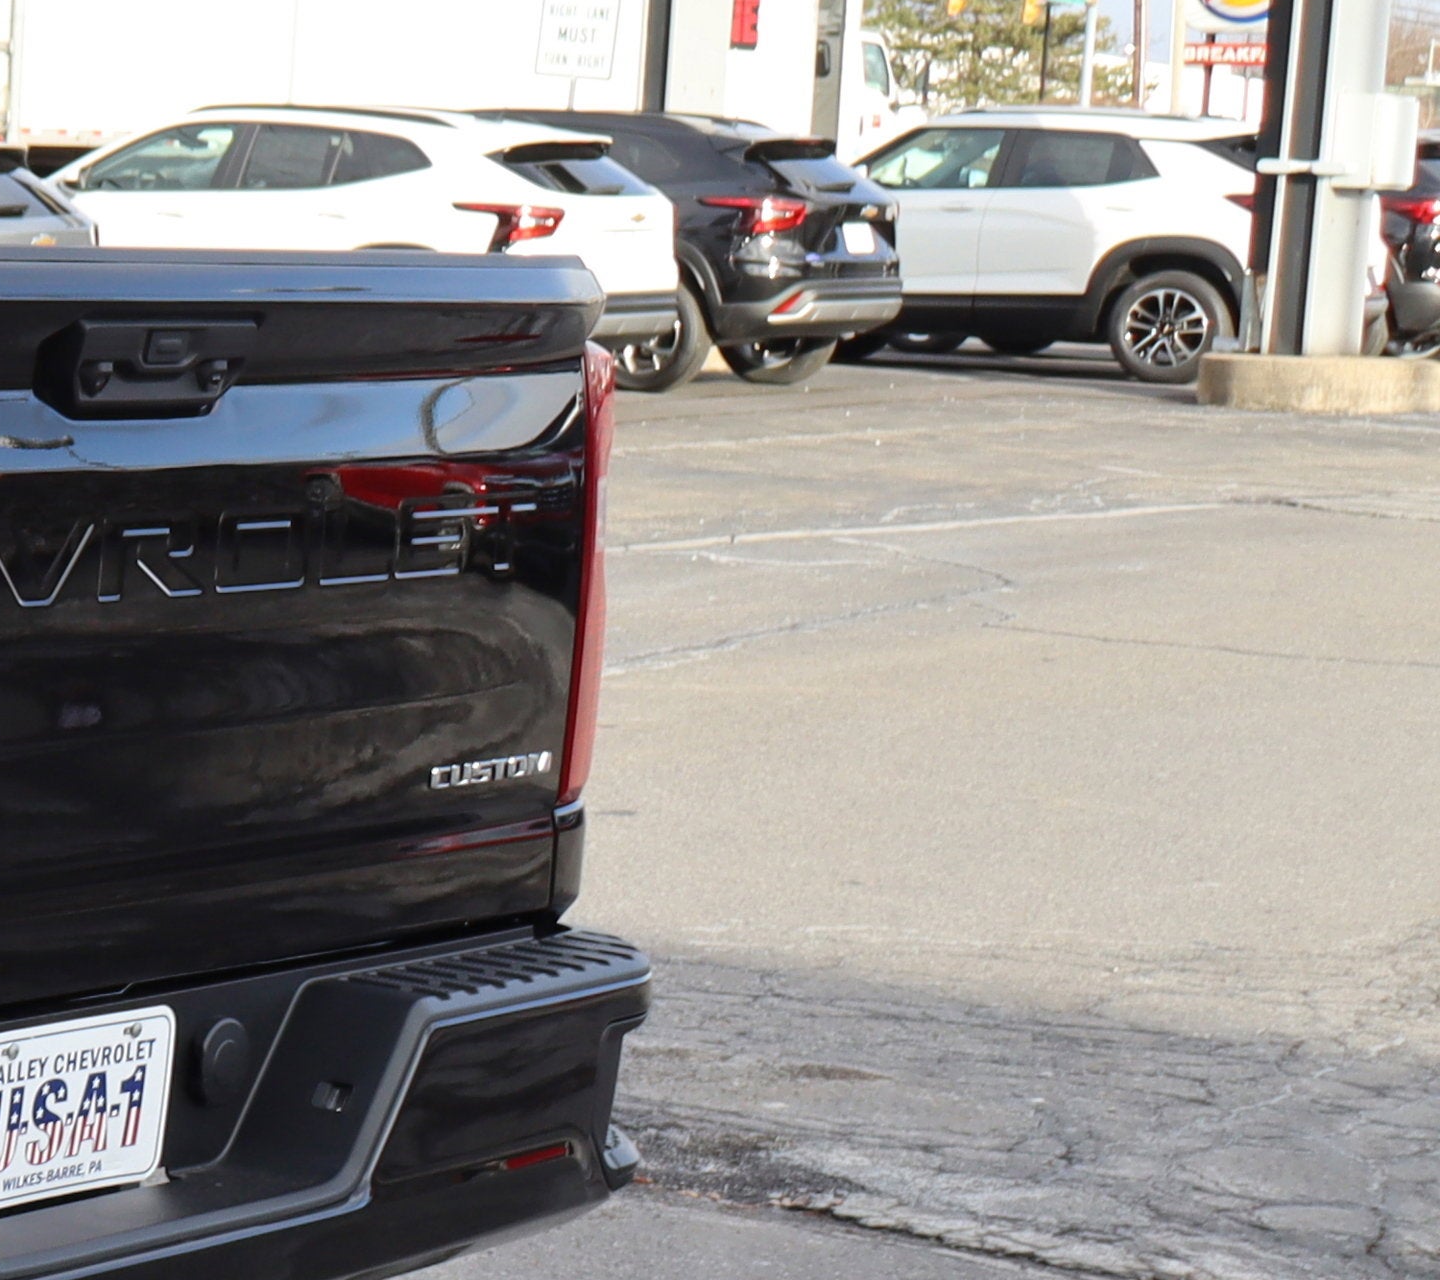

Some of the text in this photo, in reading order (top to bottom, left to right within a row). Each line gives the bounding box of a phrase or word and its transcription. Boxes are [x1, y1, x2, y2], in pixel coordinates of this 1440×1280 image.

[558, 26, 597, 44] MUST
[1184, 45, 1266, 62] BREAKF
[430, 751, 552, 790] CUSTOM
[53, 1038, 157, 1075] CHEVROLET
[88, 1159, 103, 1176] PA
